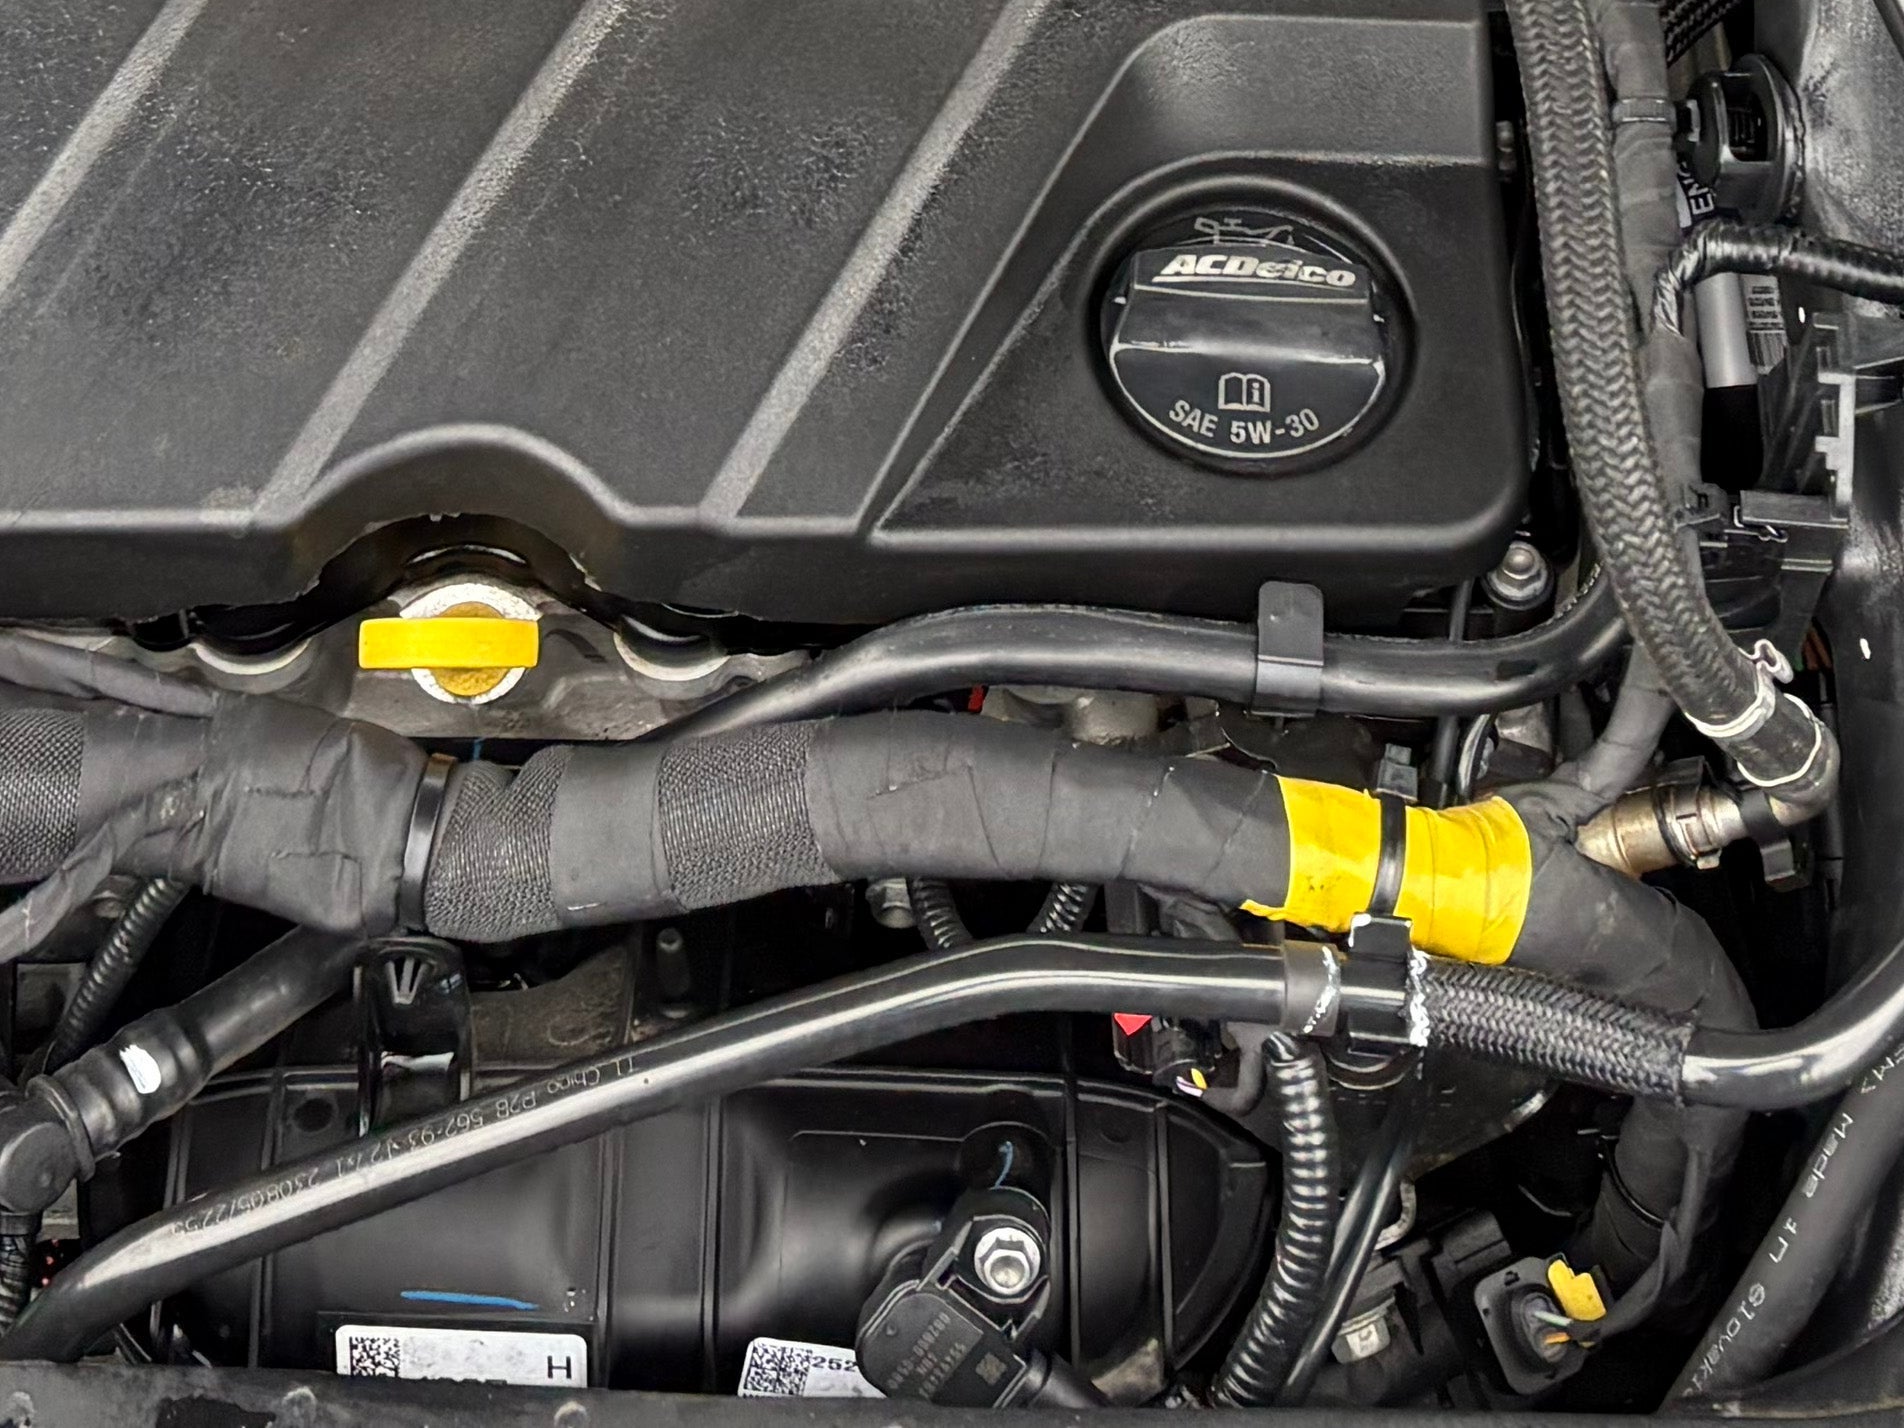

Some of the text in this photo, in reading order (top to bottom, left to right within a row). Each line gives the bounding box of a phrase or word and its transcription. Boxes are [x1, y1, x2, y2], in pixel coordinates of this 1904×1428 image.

[1154, 254, 1356, 287] ACDelco
[1168, 399, 1320, 444] SAE 5W-30
[1802, 1112, 1855, 1199] Made
[546, 1355, 574, 1380] H
